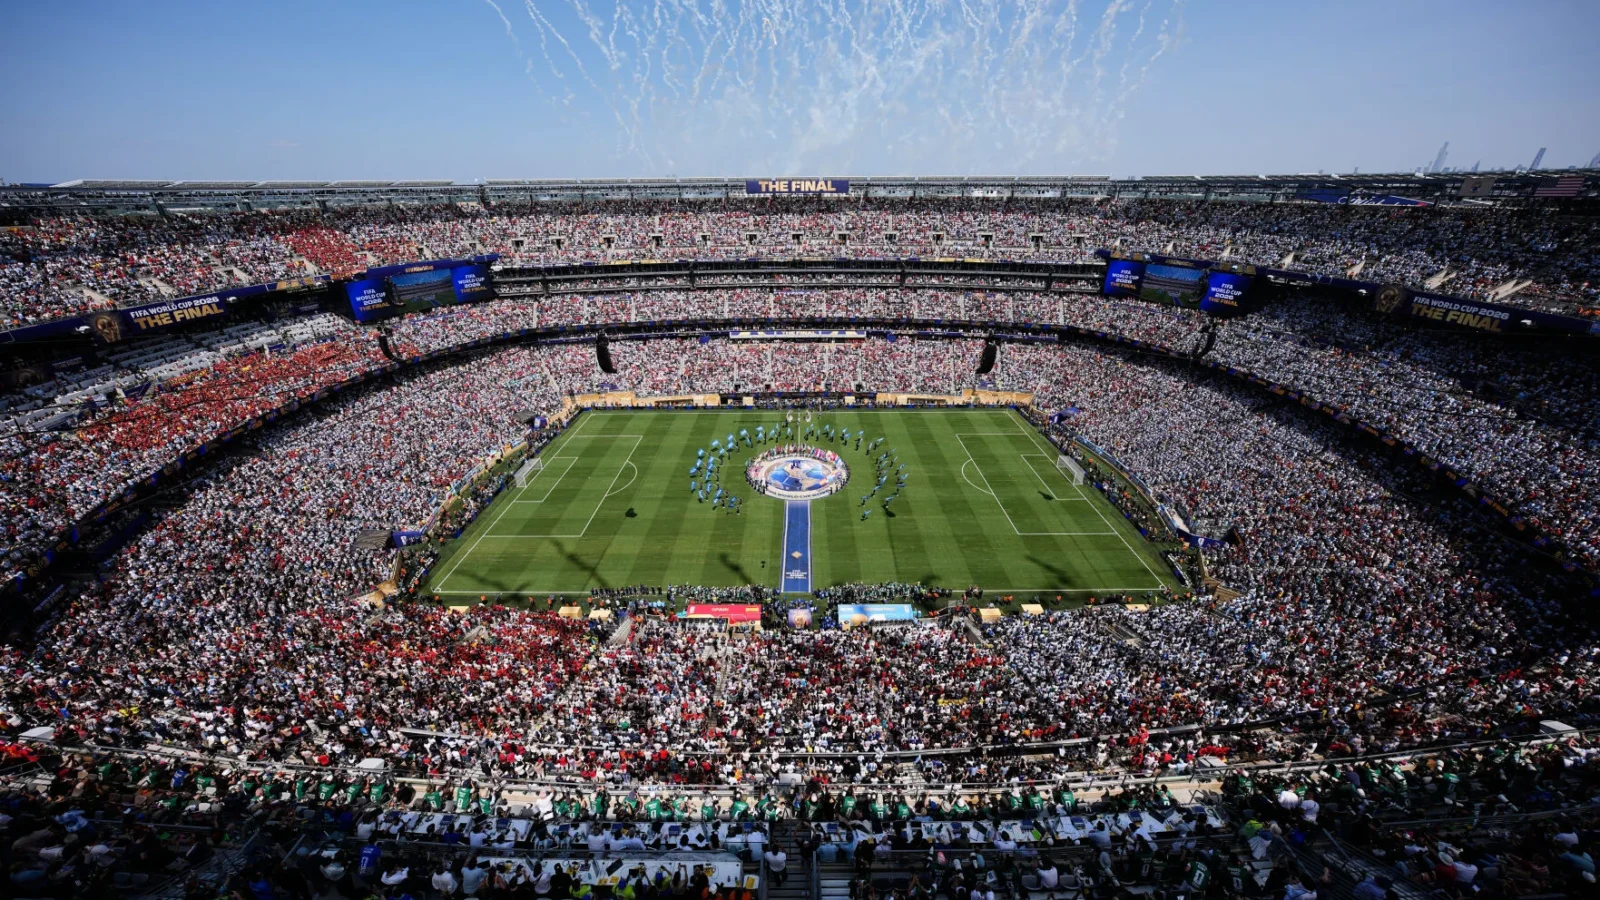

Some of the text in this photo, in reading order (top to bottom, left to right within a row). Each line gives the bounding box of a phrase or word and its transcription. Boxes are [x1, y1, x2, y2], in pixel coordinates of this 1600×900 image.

[758, 180, 836, 192] THE FINAL
[1211, 286, 1230, 294] WORLD
[130, 296, 220, 319] FIFA WORLD CUP 2026
[133, 303, 224, 330] THE FINAL
[1411, 303, 1502, 332] THE FINAL
[1413, 296, 1510, 320] FIFA WORLD CUP 2026
